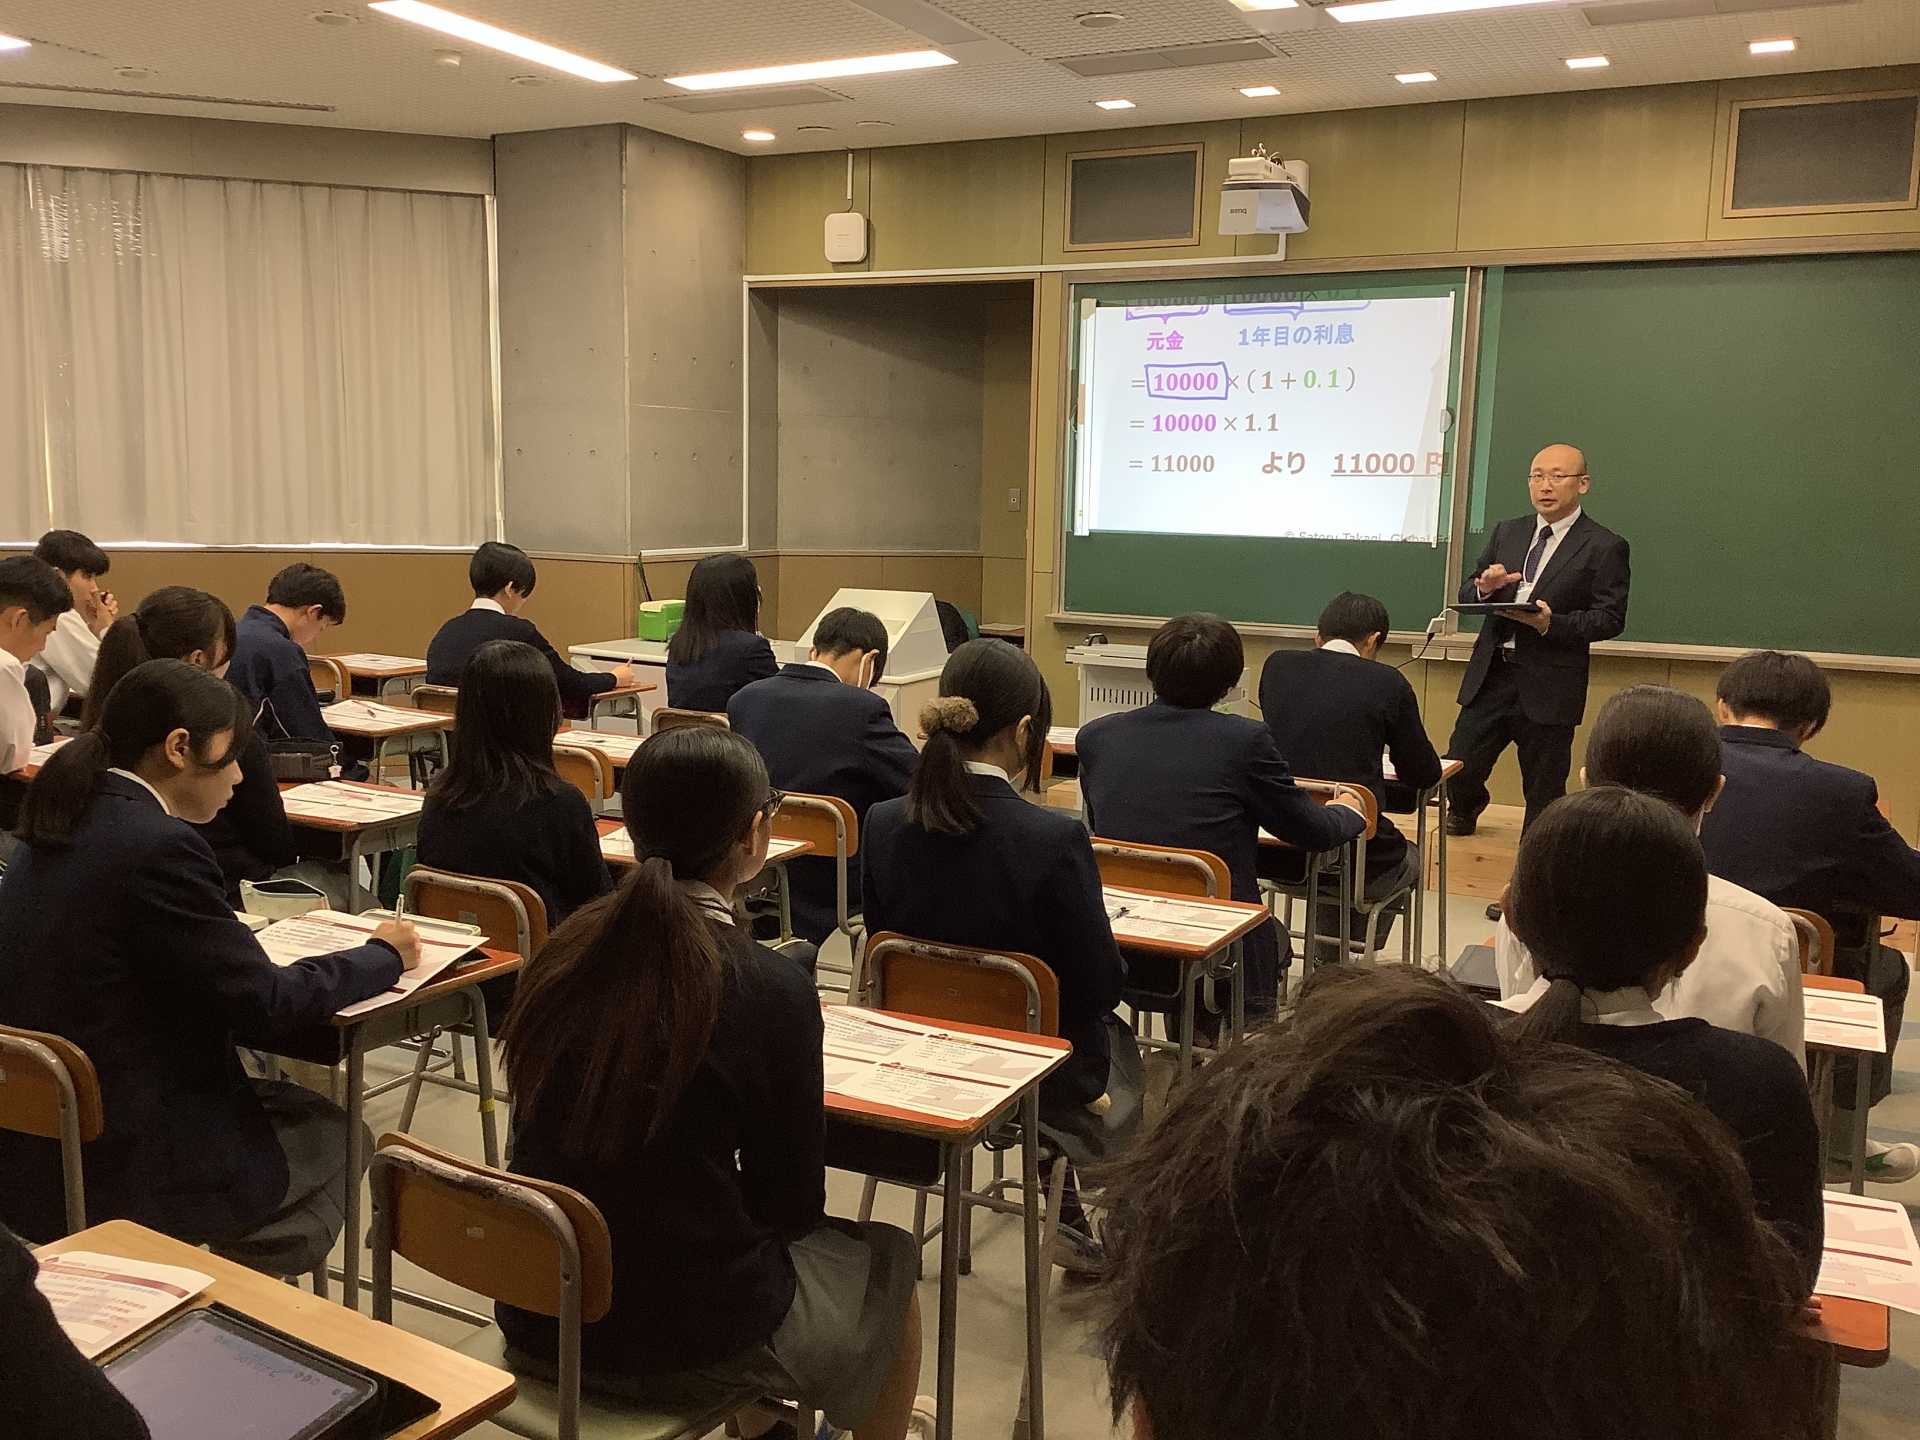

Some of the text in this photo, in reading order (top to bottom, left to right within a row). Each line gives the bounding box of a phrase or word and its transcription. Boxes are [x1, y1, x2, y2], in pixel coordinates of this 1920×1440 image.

[1146, 329, 1184, 351] 元金
[1238, 322, 1355, 348] 1年目の利息
[1153, 371, 1218, 392] 10000
[1152, 413, 1217, 433] 10000
[1245, 413, 1279, 432] 1.1
[1151, 454, 1215, 473] 11000
[1261, 451, 1306, 475] より
[1333, 452, 1416, 474] 11000
